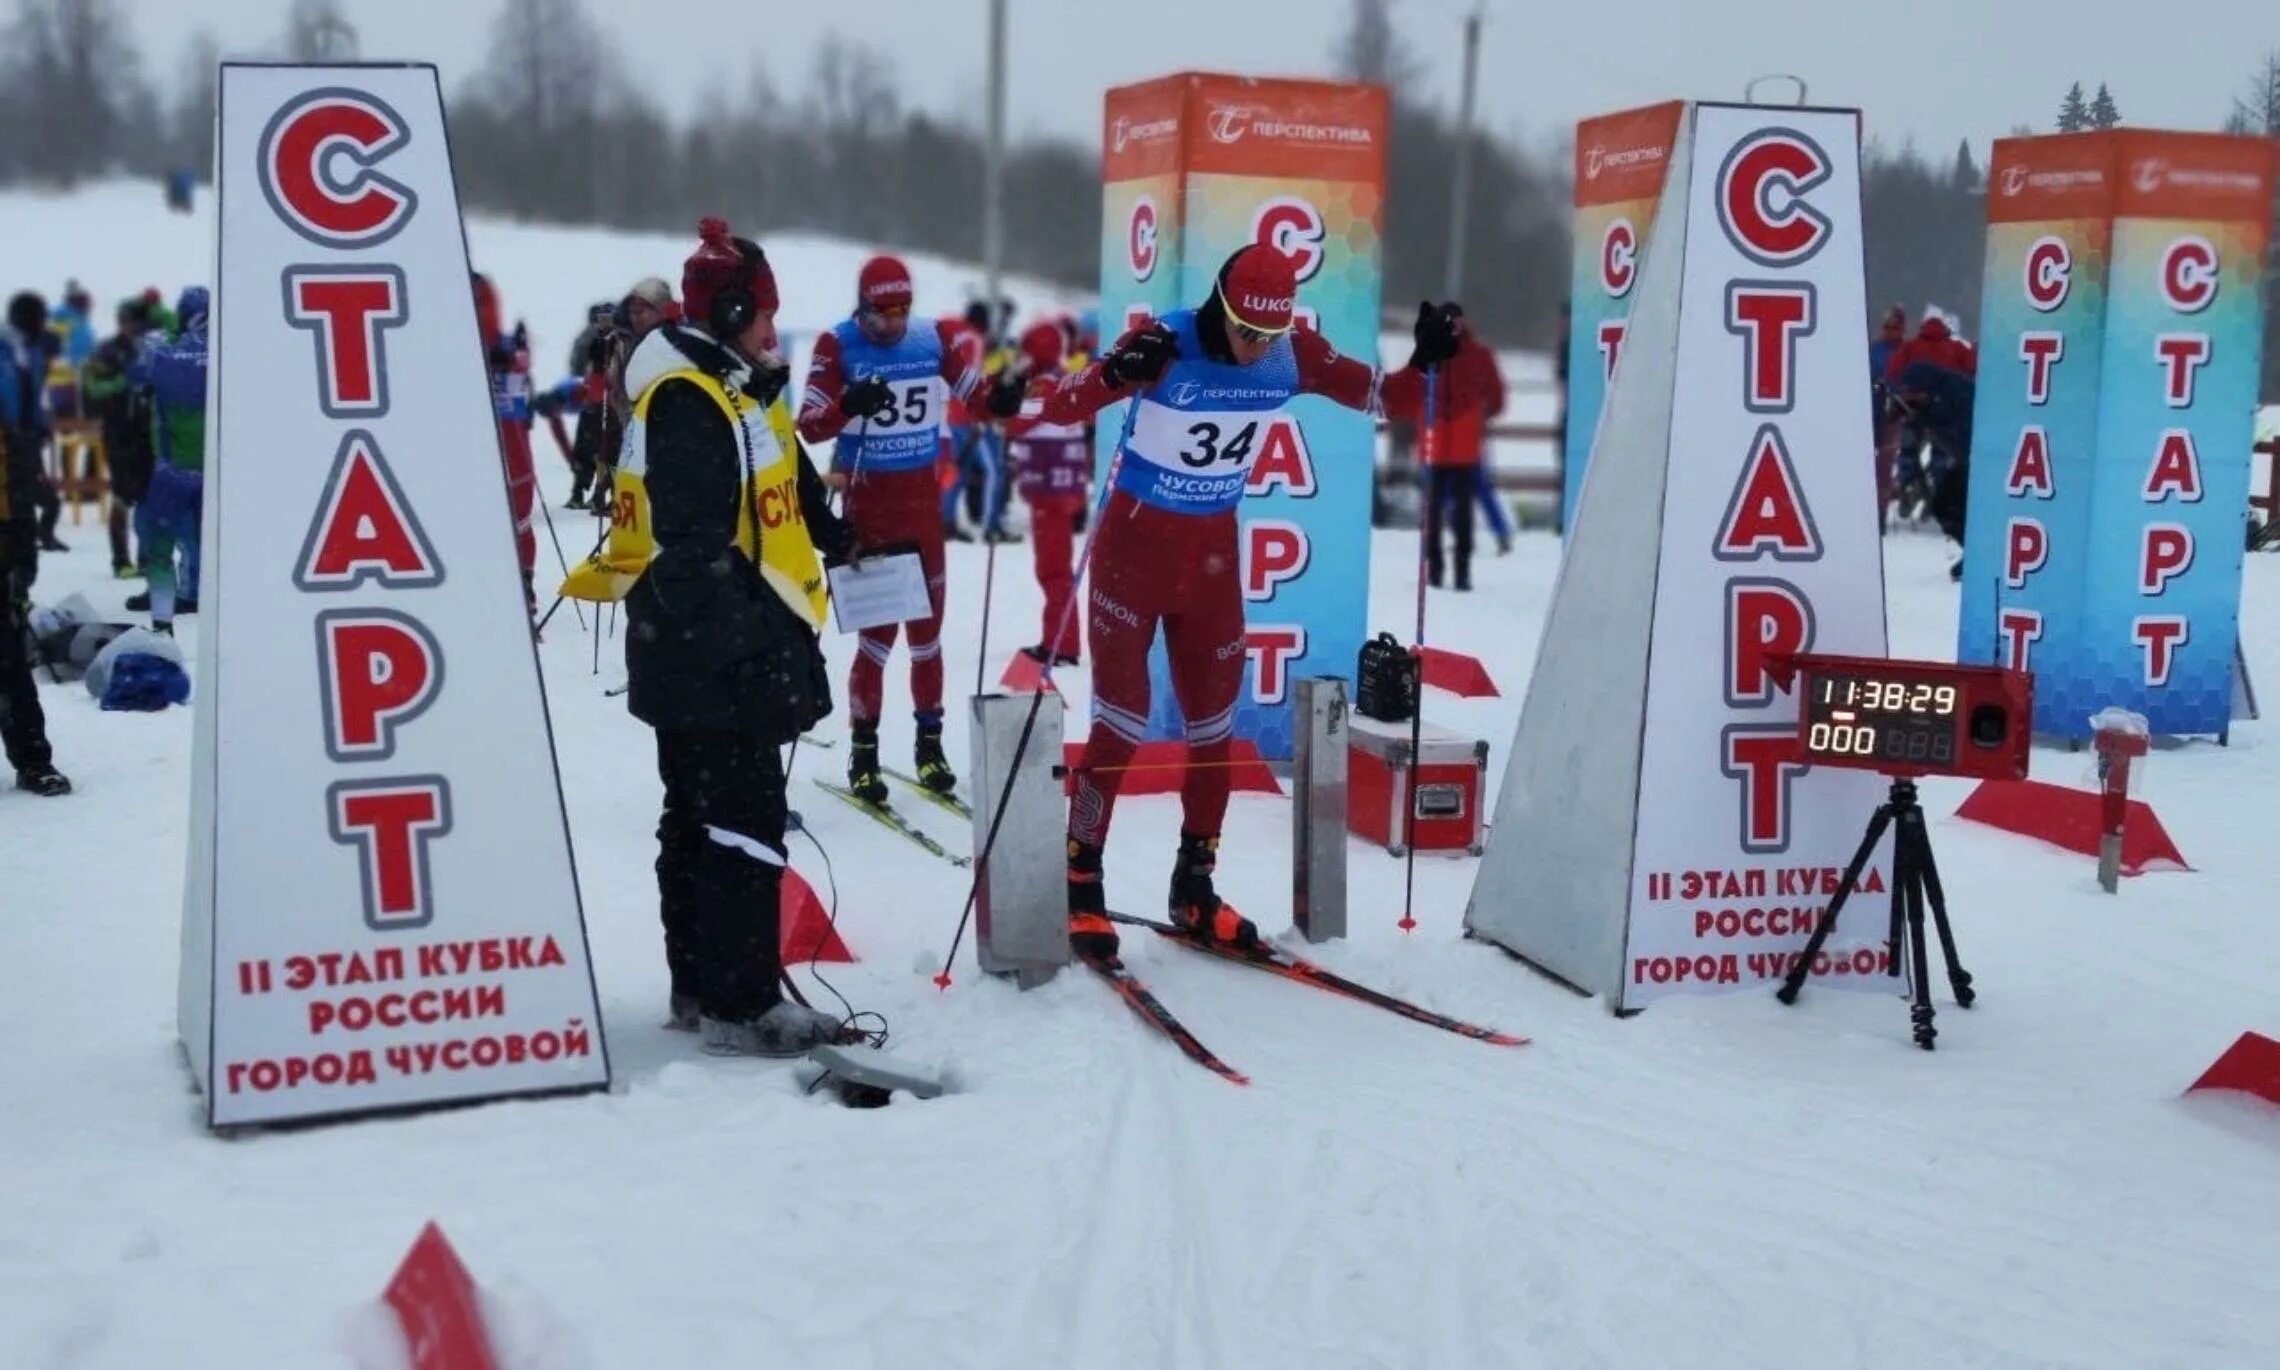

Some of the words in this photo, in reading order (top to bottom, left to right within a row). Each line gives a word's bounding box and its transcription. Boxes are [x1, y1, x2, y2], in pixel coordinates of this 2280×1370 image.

[1252, 121, 1372, 142] ПЕРСПЕКТИВА
[873, 386, 928, 427] 35
[1202, 388, 1290, 400] ПЕРСПЕКТИВА
[1179, 421, 1258, 468] 34
[1243, 194, 1326, 705] САРТ
[2001, 235, 2072, 673] СТАРТ
[2134, 235, 2218, 687] СТАРТ
[257, 87, 453, 930] СТАРТ
[1712, 126, 1833, 854] СТАРТ
[1824, 679, 1956, 715] 11:38:29
[1809, 723, 1876, 755] 000
[1680, 869, 1766, 900] ЭТАП
[284, 948, 405, 990] ЭТАП
[418, 934, 566, 978] КУБКА
[1634, 954, 1740, 985] ГОРОД
[309, 985, 506, 1034] РОССИИ
[227, 1050, 376, 1094] ГОРОД
[385, 1018, 590, 1076] ЧУСОВОЙ
